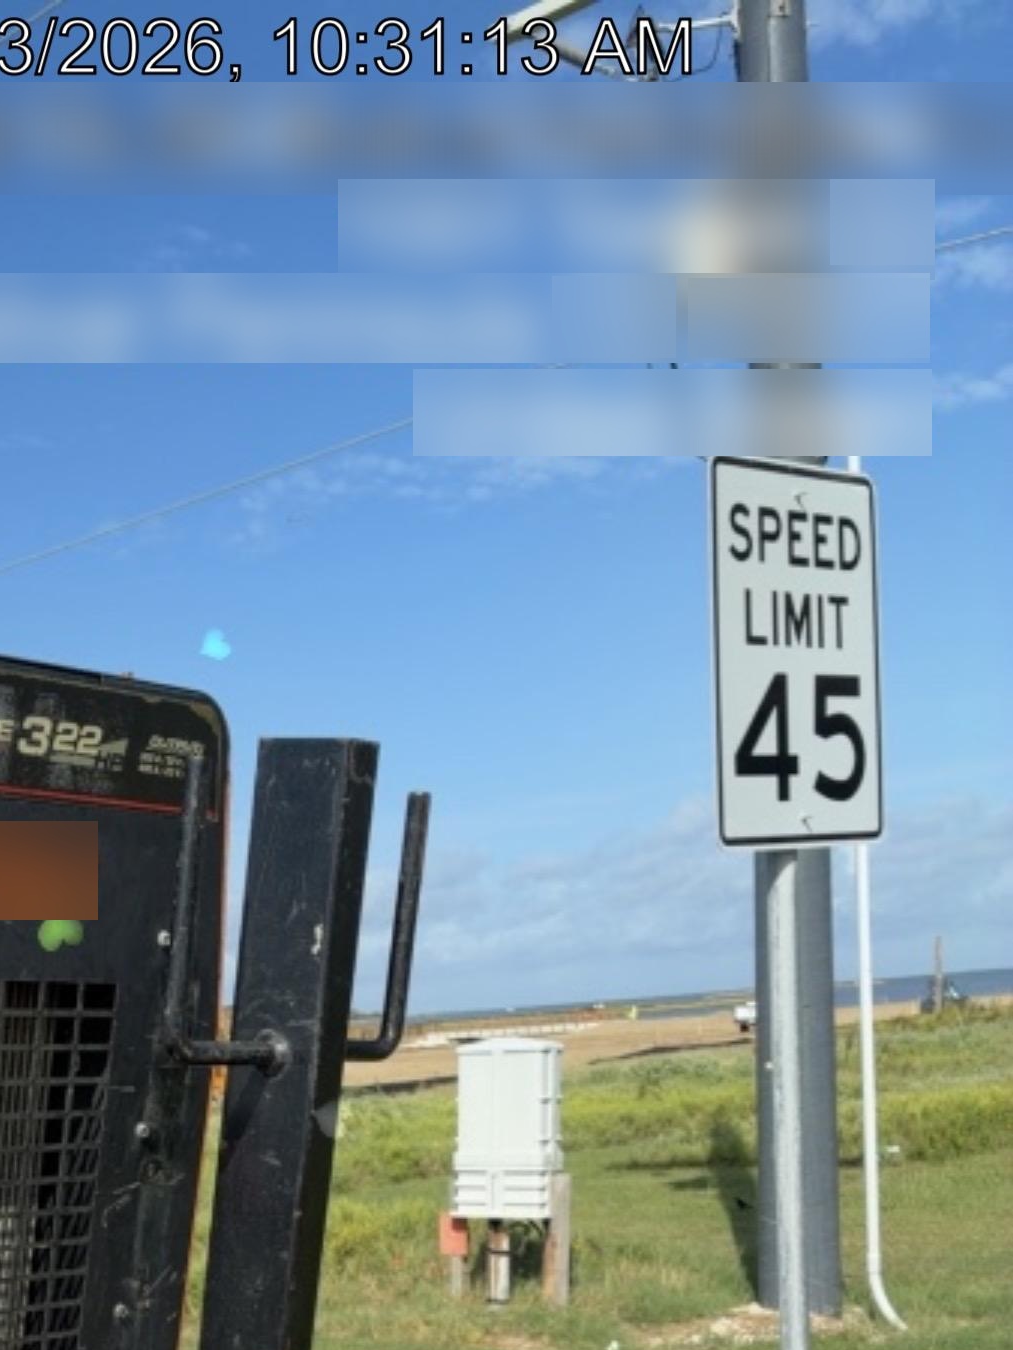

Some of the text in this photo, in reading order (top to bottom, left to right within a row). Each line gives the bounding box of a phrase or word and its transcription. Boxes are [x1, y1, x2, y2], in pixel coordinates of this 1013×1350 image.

[729, 502, 861, 571] SPEED
[744, 588, 849, 649] LIMIT
[17, 715, 103, 758] 322
[734, 672, 867, 802] 45
